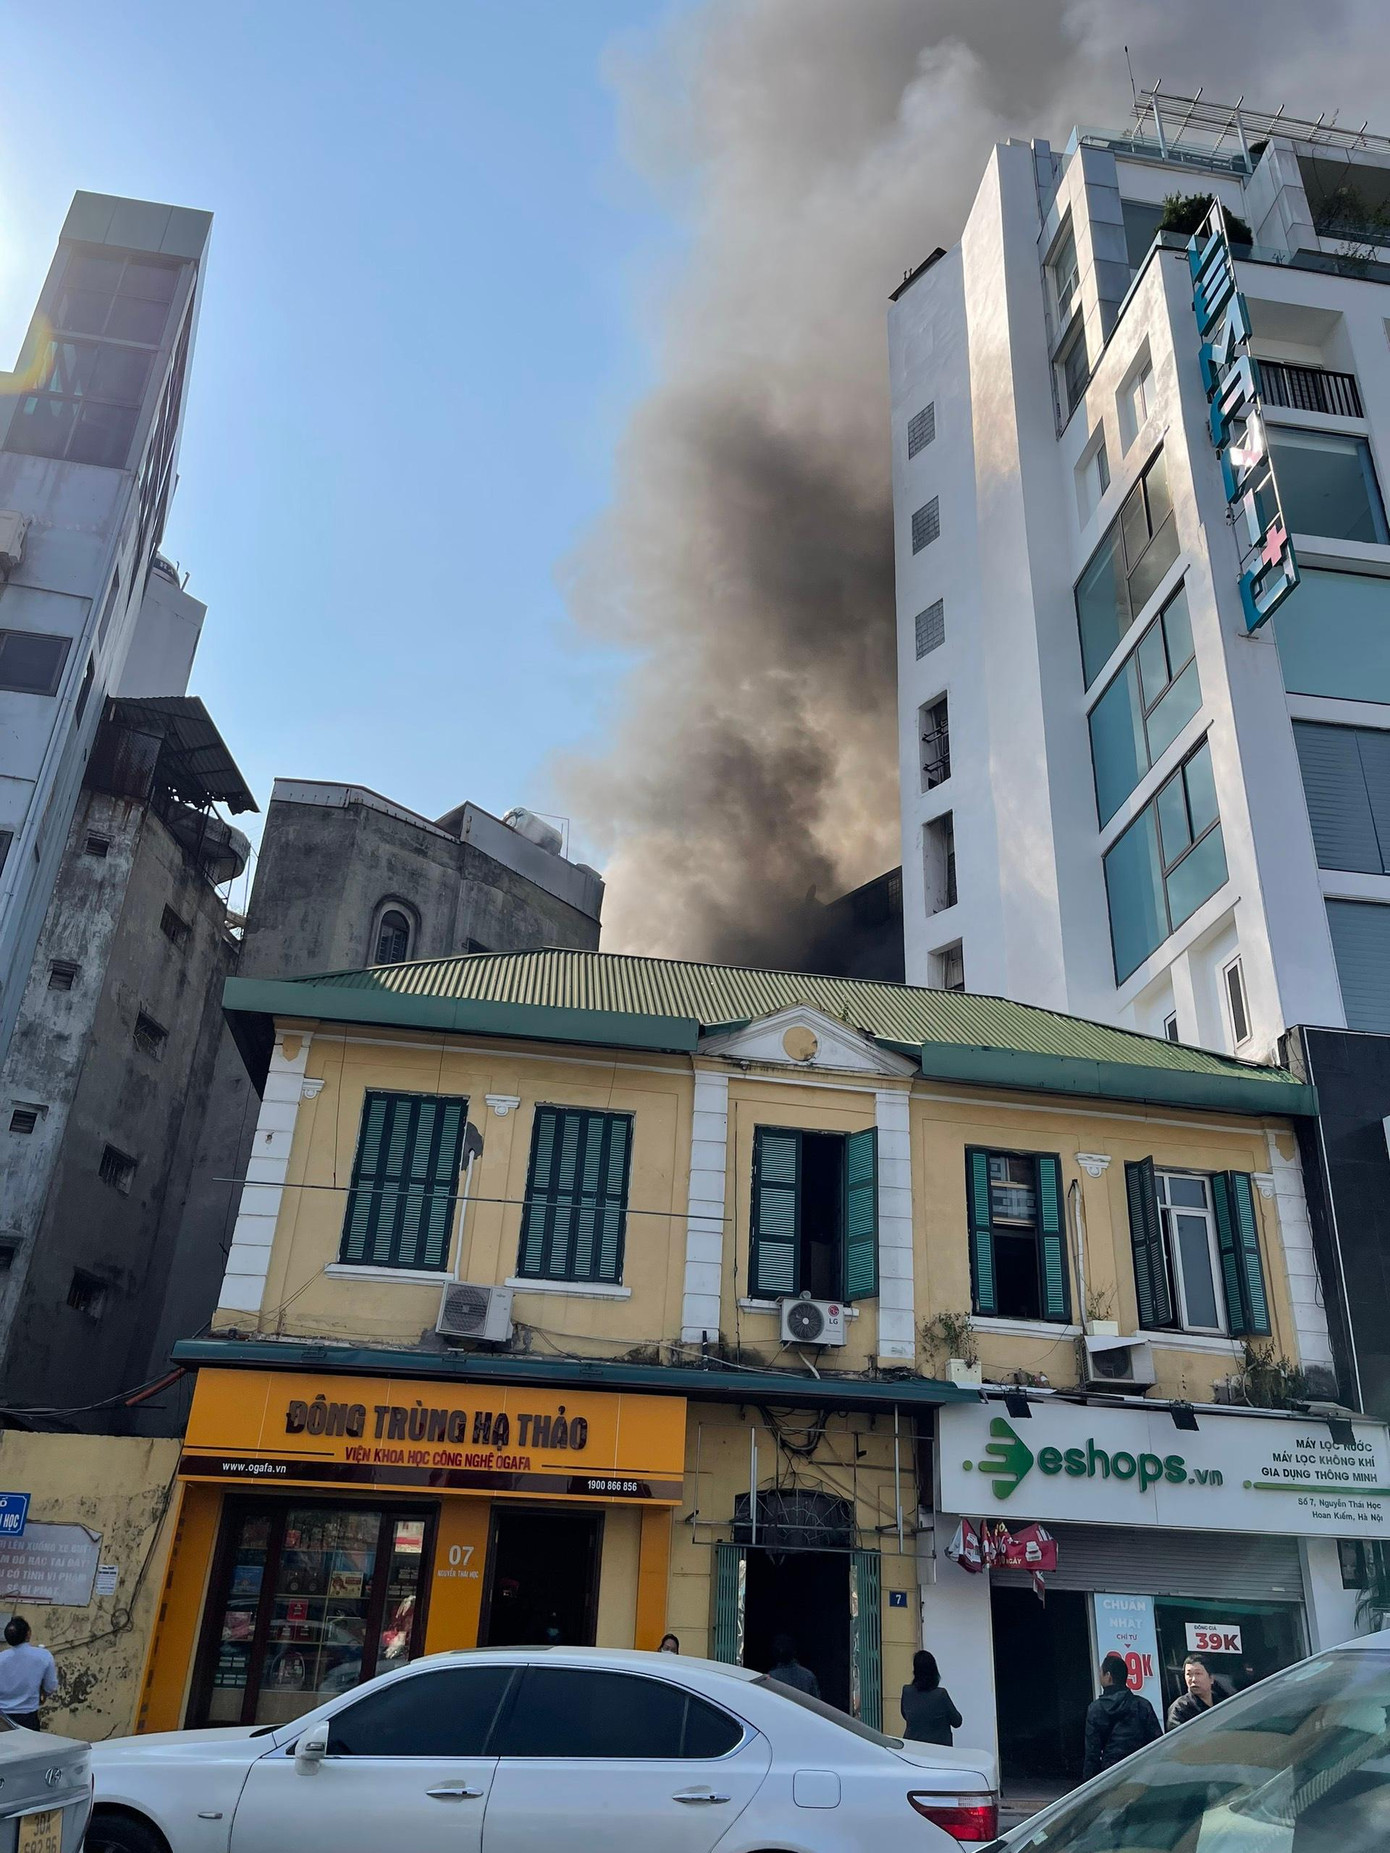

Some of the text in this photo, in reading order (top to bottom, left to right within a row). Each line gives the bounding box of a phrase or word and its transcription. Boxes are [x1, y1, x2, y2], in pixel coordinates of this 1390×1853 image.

[285, 1394, 588, 1451] ĐÔNG TRÙNG HẠ THẢO
[1296, 1437, 1316, 1448] MÁY
[1320, 1441, 1340, 1452] LỌC
[345, 1445, 531, 1471] VIỆN KHOA HỌC CÔNG NGHỆ OGAFA
[1037, 1437, 1224, 1493] eshops.vn
[1272, 1450, 1375, 1467] MÁY LỌC KHÔNG KHÍ
[222, 1462, 287, 1474] www.ogafa.vn
[1261, 1467, 1378, 1483] GIA DỤNG THÔNG MINH
[587, 1480, 638, 1492] 1900 866 856
[1297, 1497, 1308, 1506] Số
[1366, 1501, 1381, 1510] Học
[3, 1514, 20, 1531] HỌC
[449, 1545, 475, 1566] 07
[895, 1594, 902, 1605] 7
[1195, 1632, 1240, 1651] 39K
